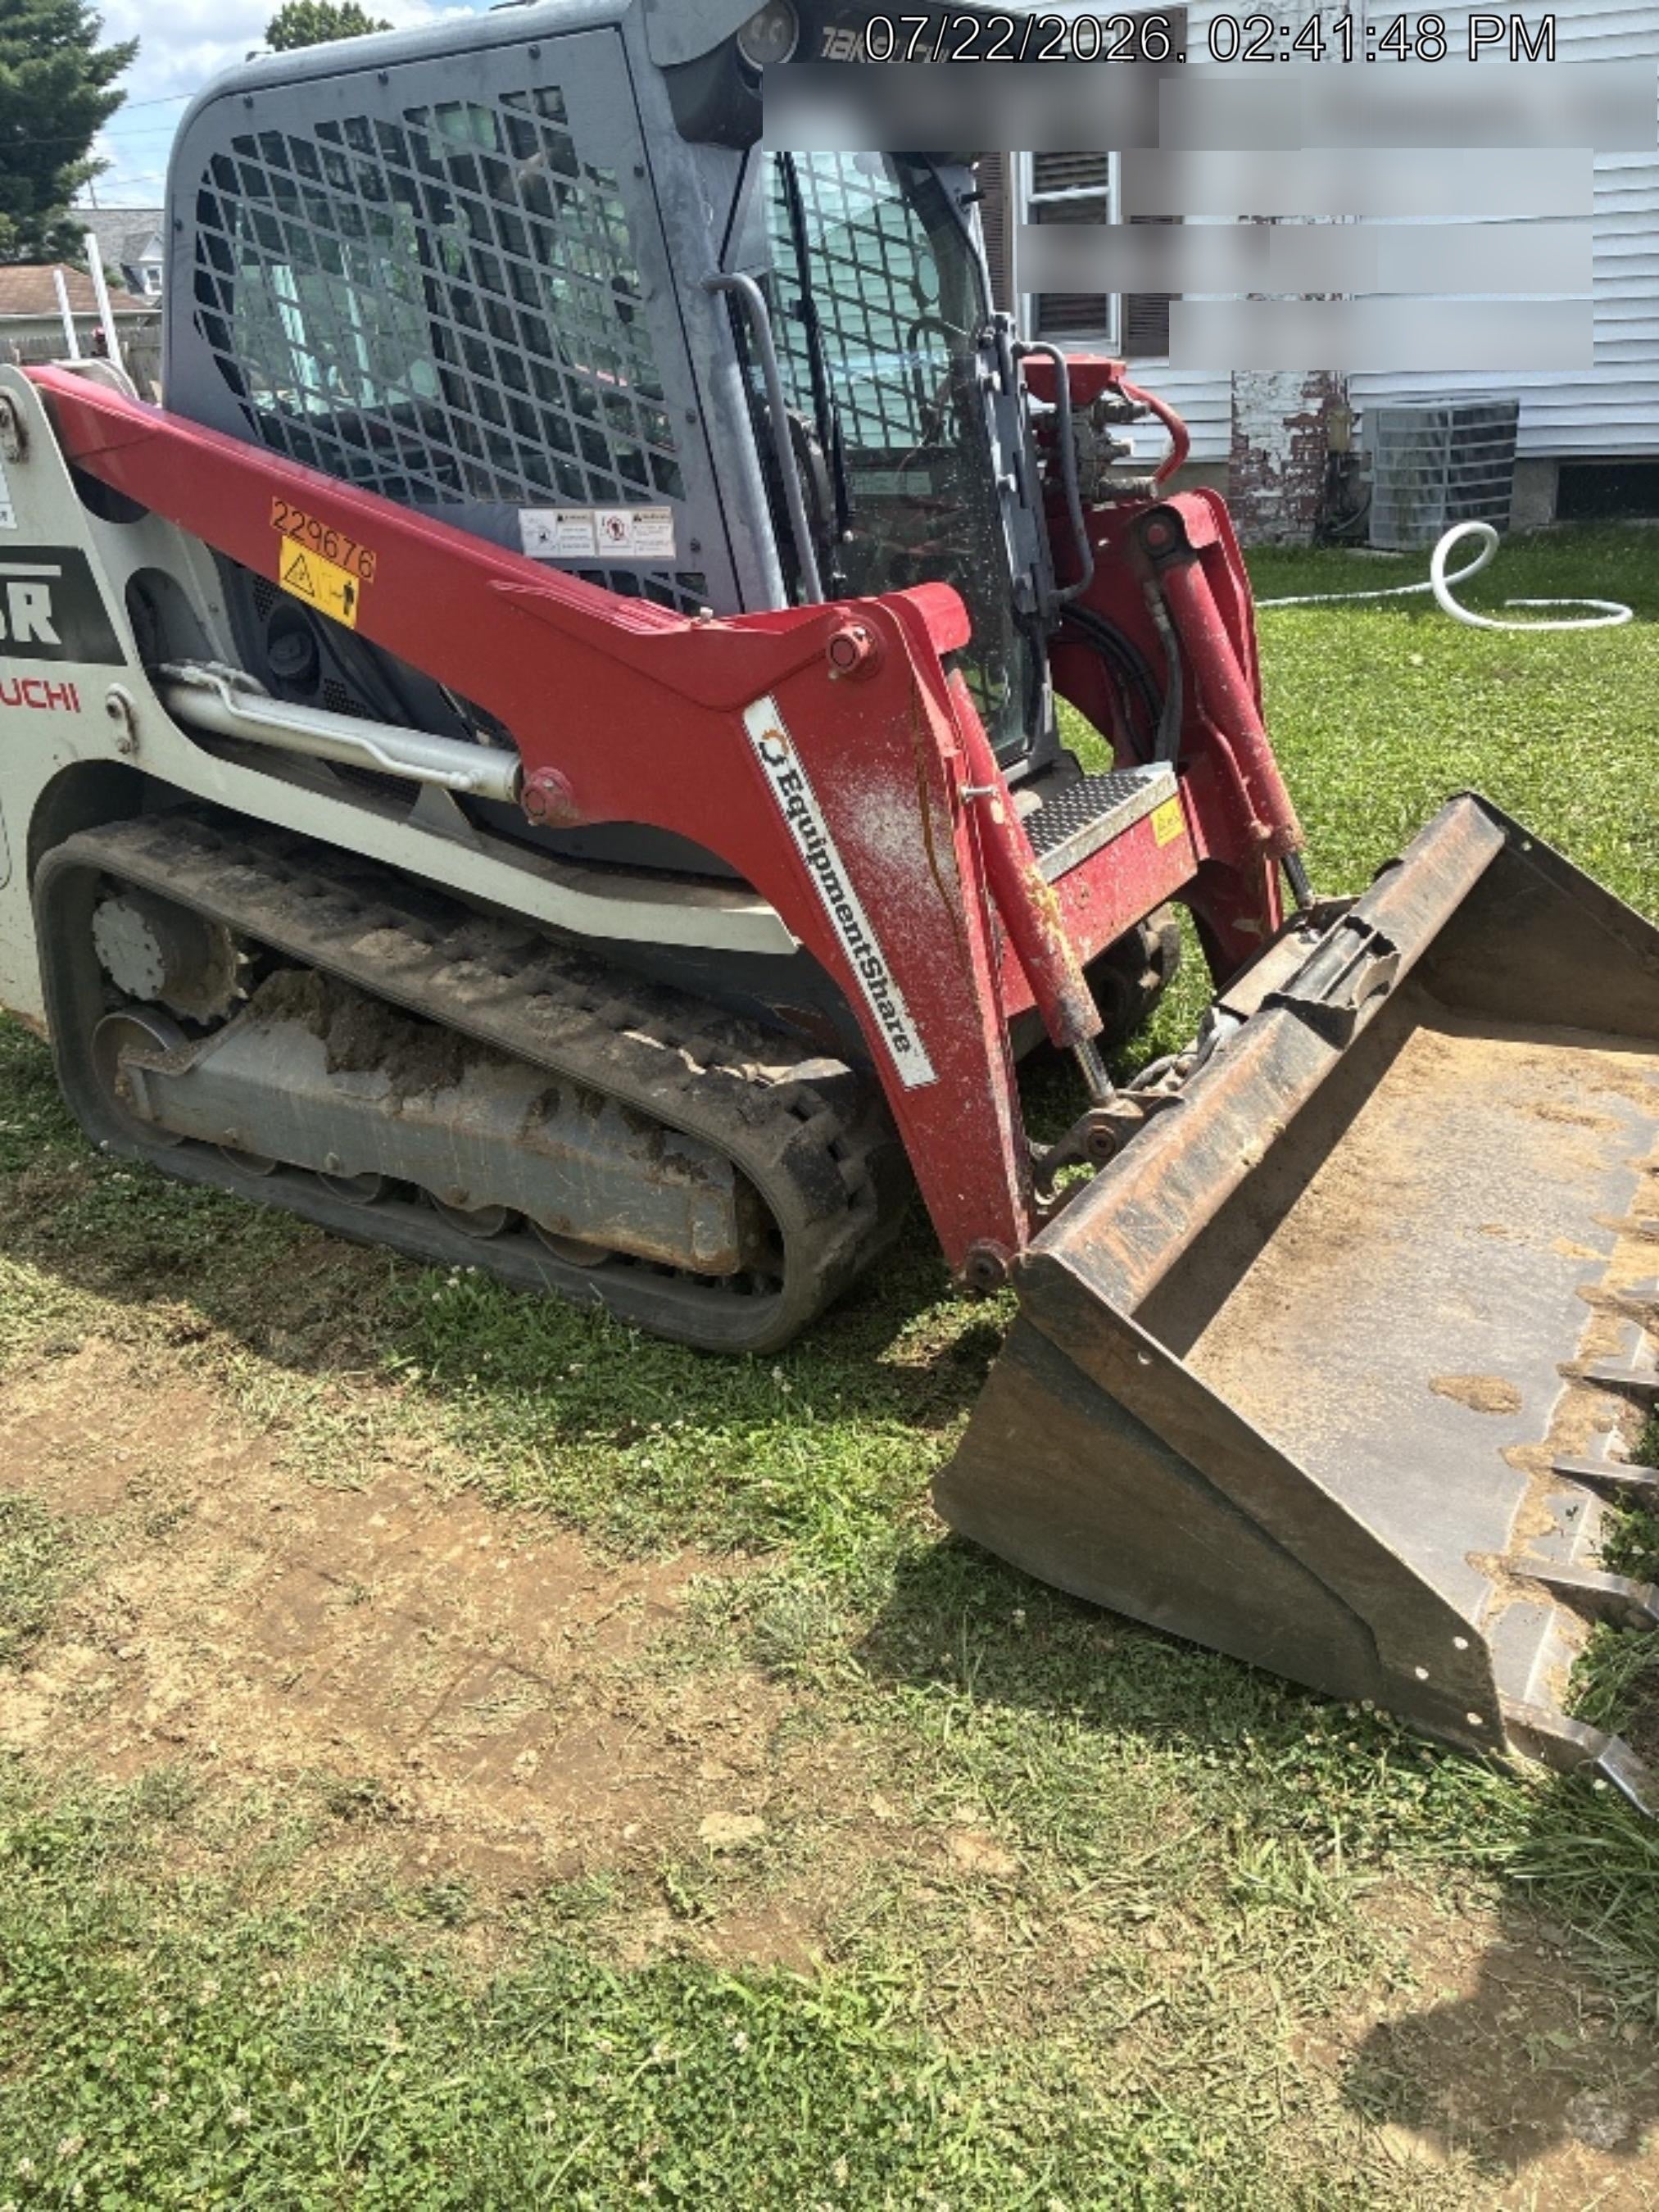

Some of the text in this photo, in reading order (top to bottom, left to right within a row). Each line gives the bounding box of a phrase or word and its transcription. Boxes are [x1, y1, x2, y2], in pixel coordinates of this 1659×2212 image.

[273, 501, 374, 578] 229676
[0, 582, 62, 645] R
[776, 769, 912, 1054] EquipmentShare
